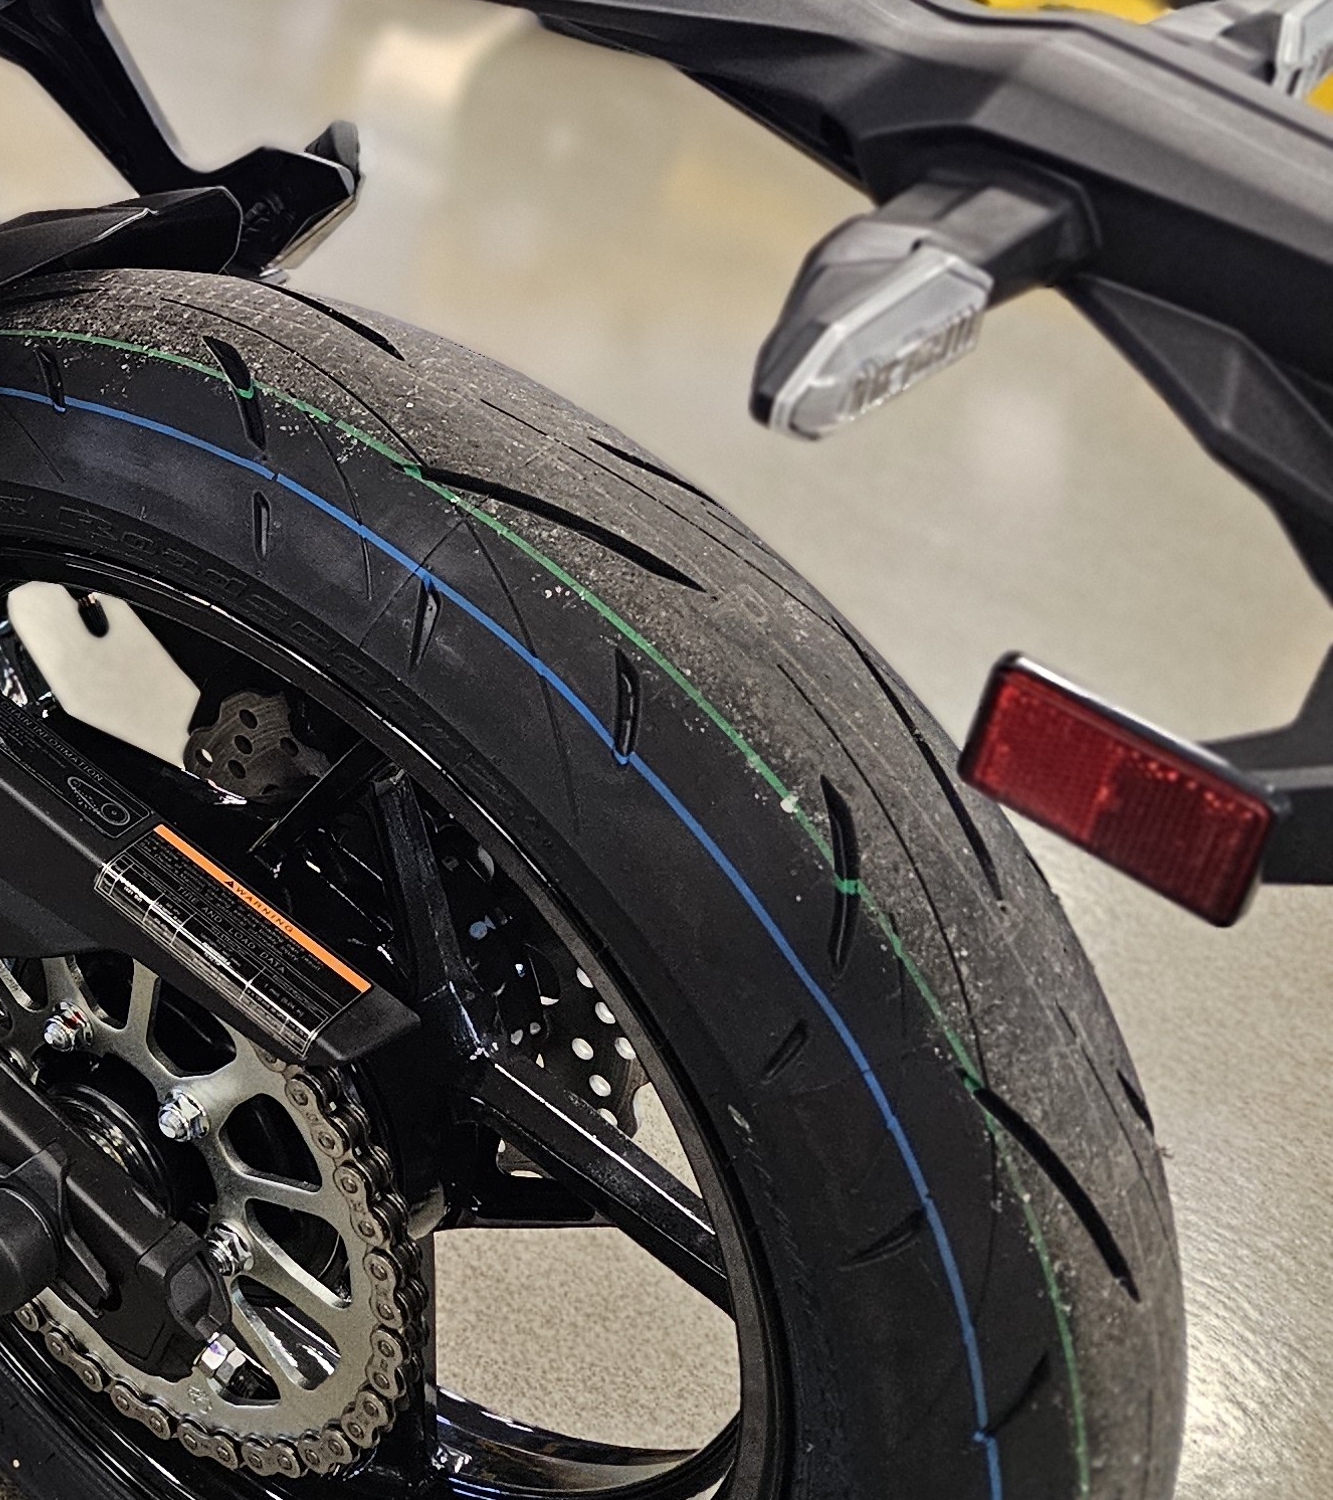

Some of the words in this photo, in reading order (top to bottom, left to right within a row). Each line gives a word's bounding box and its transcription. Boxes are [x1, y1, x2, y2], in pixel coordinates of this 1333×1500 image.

[175, 886, 200, 904] TIRE
[200, 905, 223, 923] AND
[227, 927, 257, 949] LOAD
[259, 951, 287, 973] DATA
[234, 887, 294, 932] WARNING
